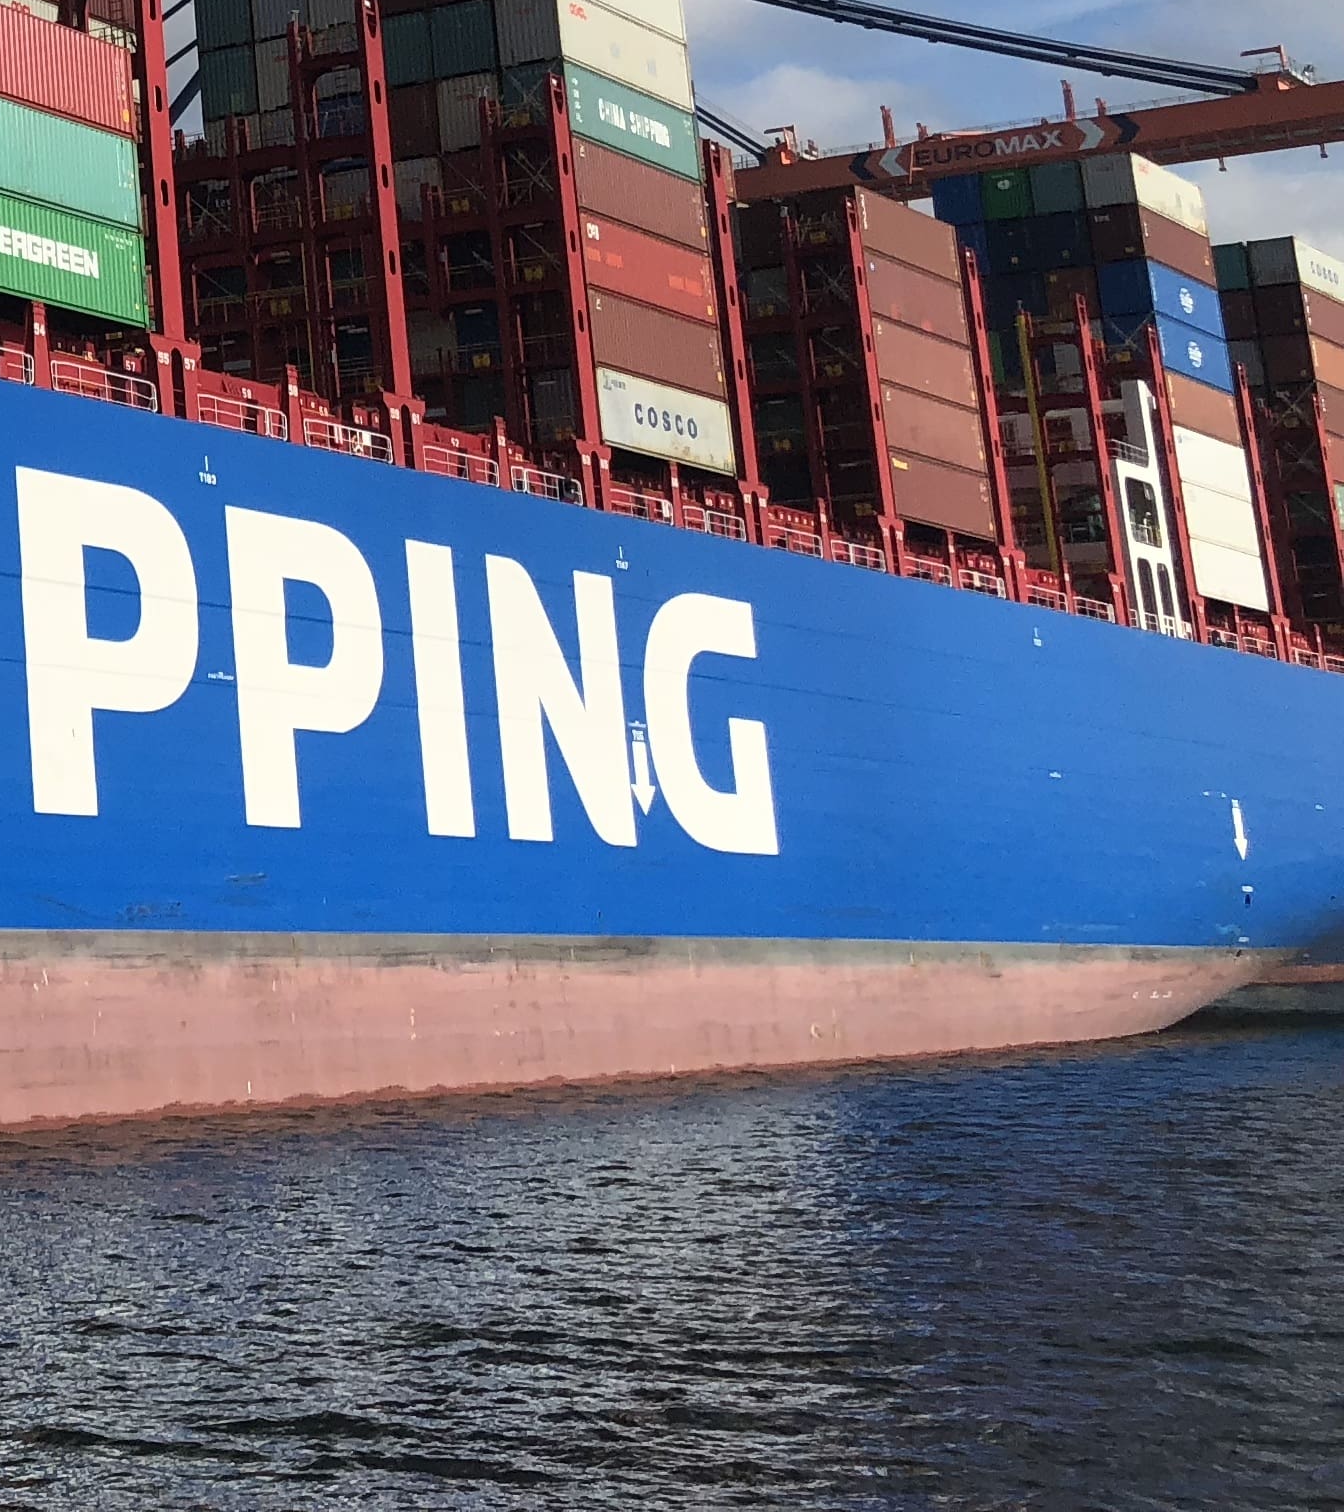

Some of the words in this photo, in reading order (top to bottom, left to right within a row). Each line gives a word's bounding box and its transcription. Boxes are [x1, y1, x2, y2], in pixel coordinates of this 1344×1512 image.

[598, 97, 627, 131] CHINA
[629, 111, 671, 148] SHIPPING
[914, 129, 1063, 166] EUROMAX
[33, 322, 46, 336] 54
[158, 351, 169, 365] 55
[184, 358, 196, 371] 57
[125, 360, 136, 372] 57
[634, 402, 698, 440] COSCO
